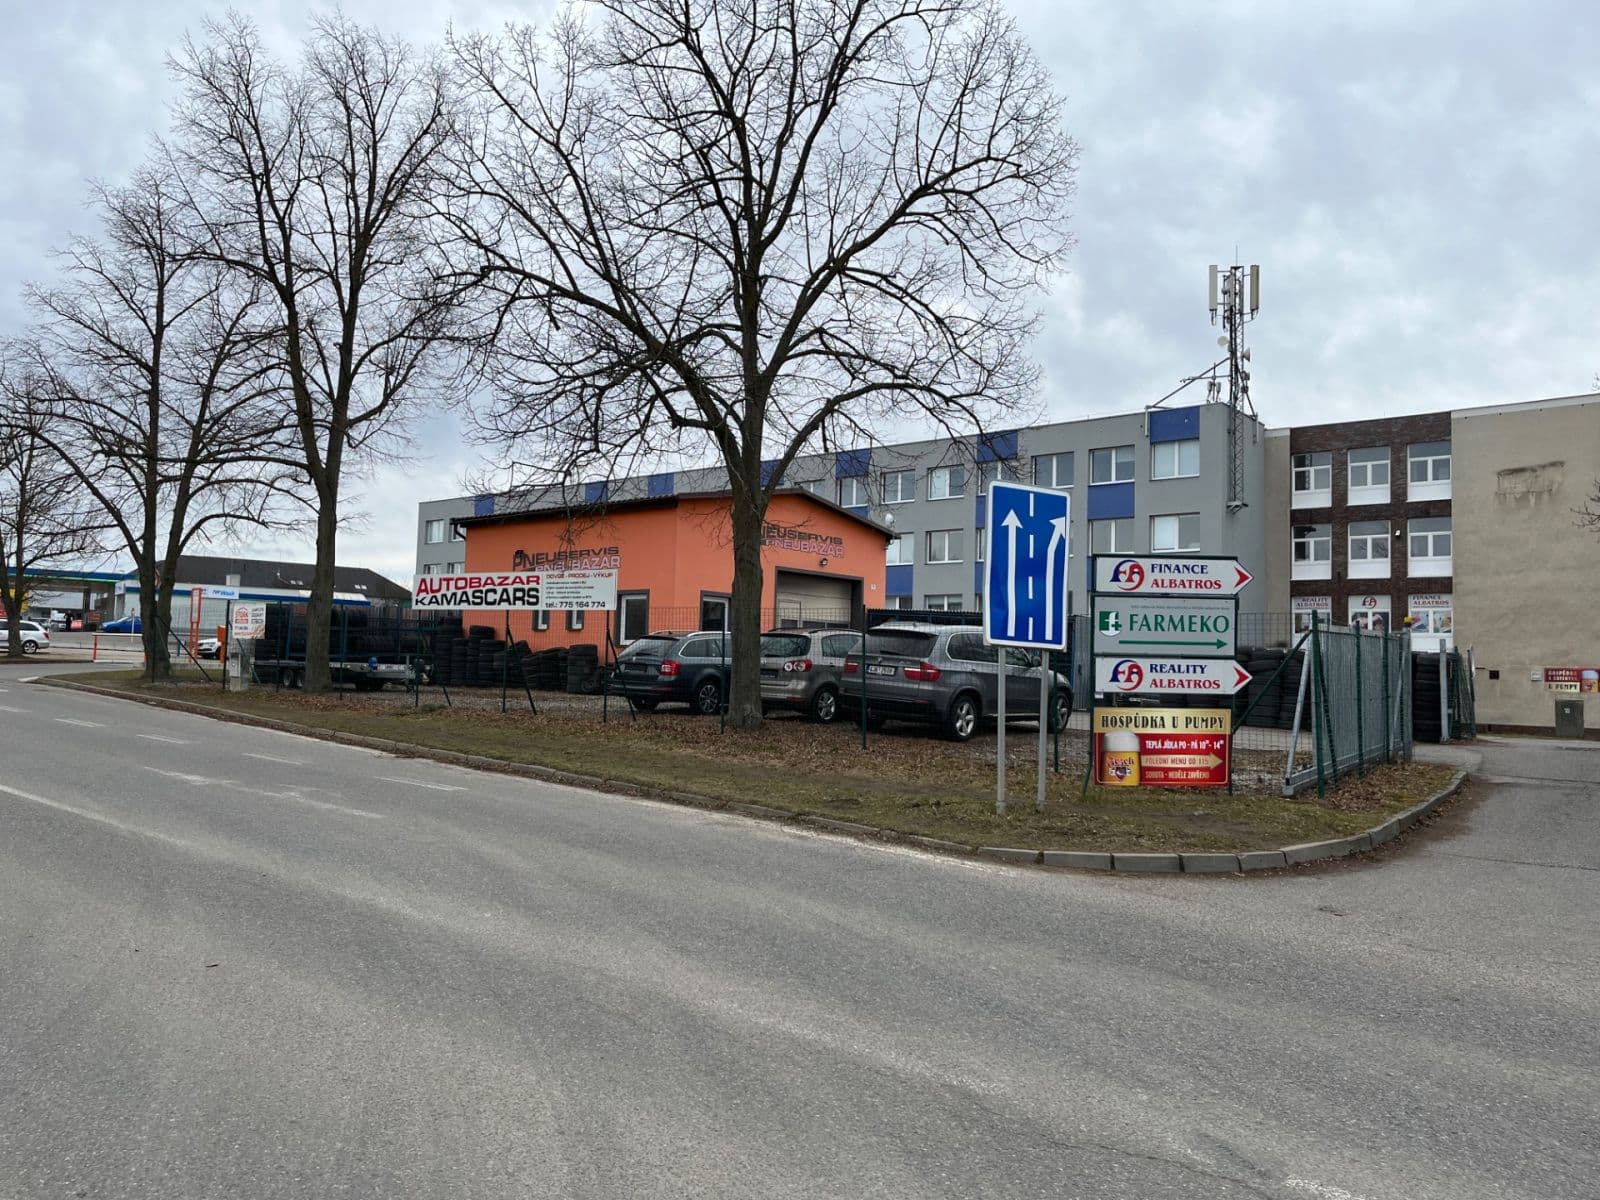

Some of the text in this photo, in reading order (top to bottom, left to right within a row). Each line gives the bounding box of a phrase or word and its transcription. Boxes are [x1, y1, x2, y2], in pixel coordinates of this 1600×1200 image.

[766, 539, 844, 557] PNEUBAZAR
[512, 546, 619, 571] PNEUSERVIS
[1150, 563, 1209, 574] FINANCE
[416, 575, 541, 597] AUTOBAZAR
[1150, 579, 1222, 589] ALBATROS
[415, 587, 540, 606] KAMASCARS
[1129, 613, 1230, 633] FARMEKO
[1149, 663, 1207, 674] REALITY
[1149, 678, 1221, 689] ALBATROS
[1101, 712, 1225, 729] HOSPŮDKA U PUMPY
